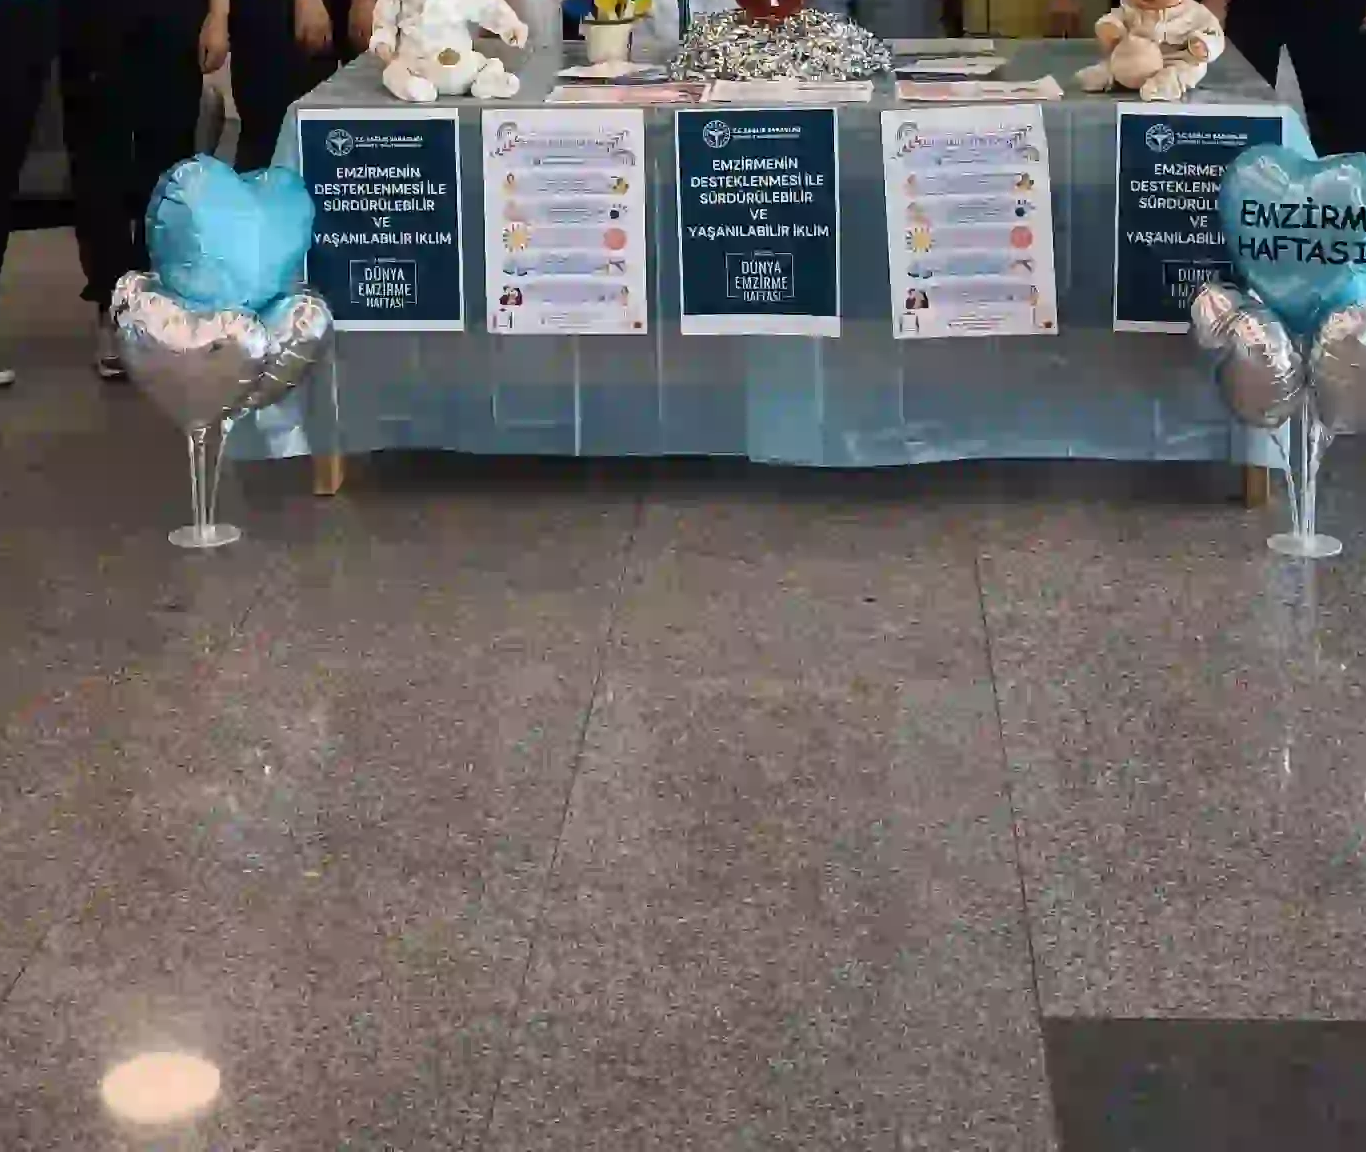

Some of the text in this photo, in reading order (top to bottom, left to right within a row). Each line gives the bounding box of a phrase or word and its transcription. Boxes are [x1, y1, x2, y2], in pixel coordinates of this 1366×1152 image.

[336, 163, 422, 179] EMZİRMENİN
[712, 156, 798, 171] EMZİRMENİN
[1154, 161, 1229, 177] EMZİRMEN
[314, 179, 447, 195] DESTEKLENMESİ İLE
[690, 171, 824, 188] DESTEKLENMESİ İLE
[323, 197, 436, 212] SÜRDÜRÜLEBİLİR
[699, 188, 813, 205] SÜRDÜRÜLEBİLİR
[371, 216, 392, 228] VE
[749, 208, 768, 220] VE
[1189, 215, 1208, 228] VE
[314, 231, 452, 248] YAŞANILABİLİR İKLİM
[687, 223, 830, 241] YAŞANILABİLİR İKLİM
[364, 265, 405, 281] DÜNYA
[741, 259, 782, 275] DÜNYA
[358, 282, 412, 297] EMZİRME
[734, 276, 788, 290] EMZİRME
